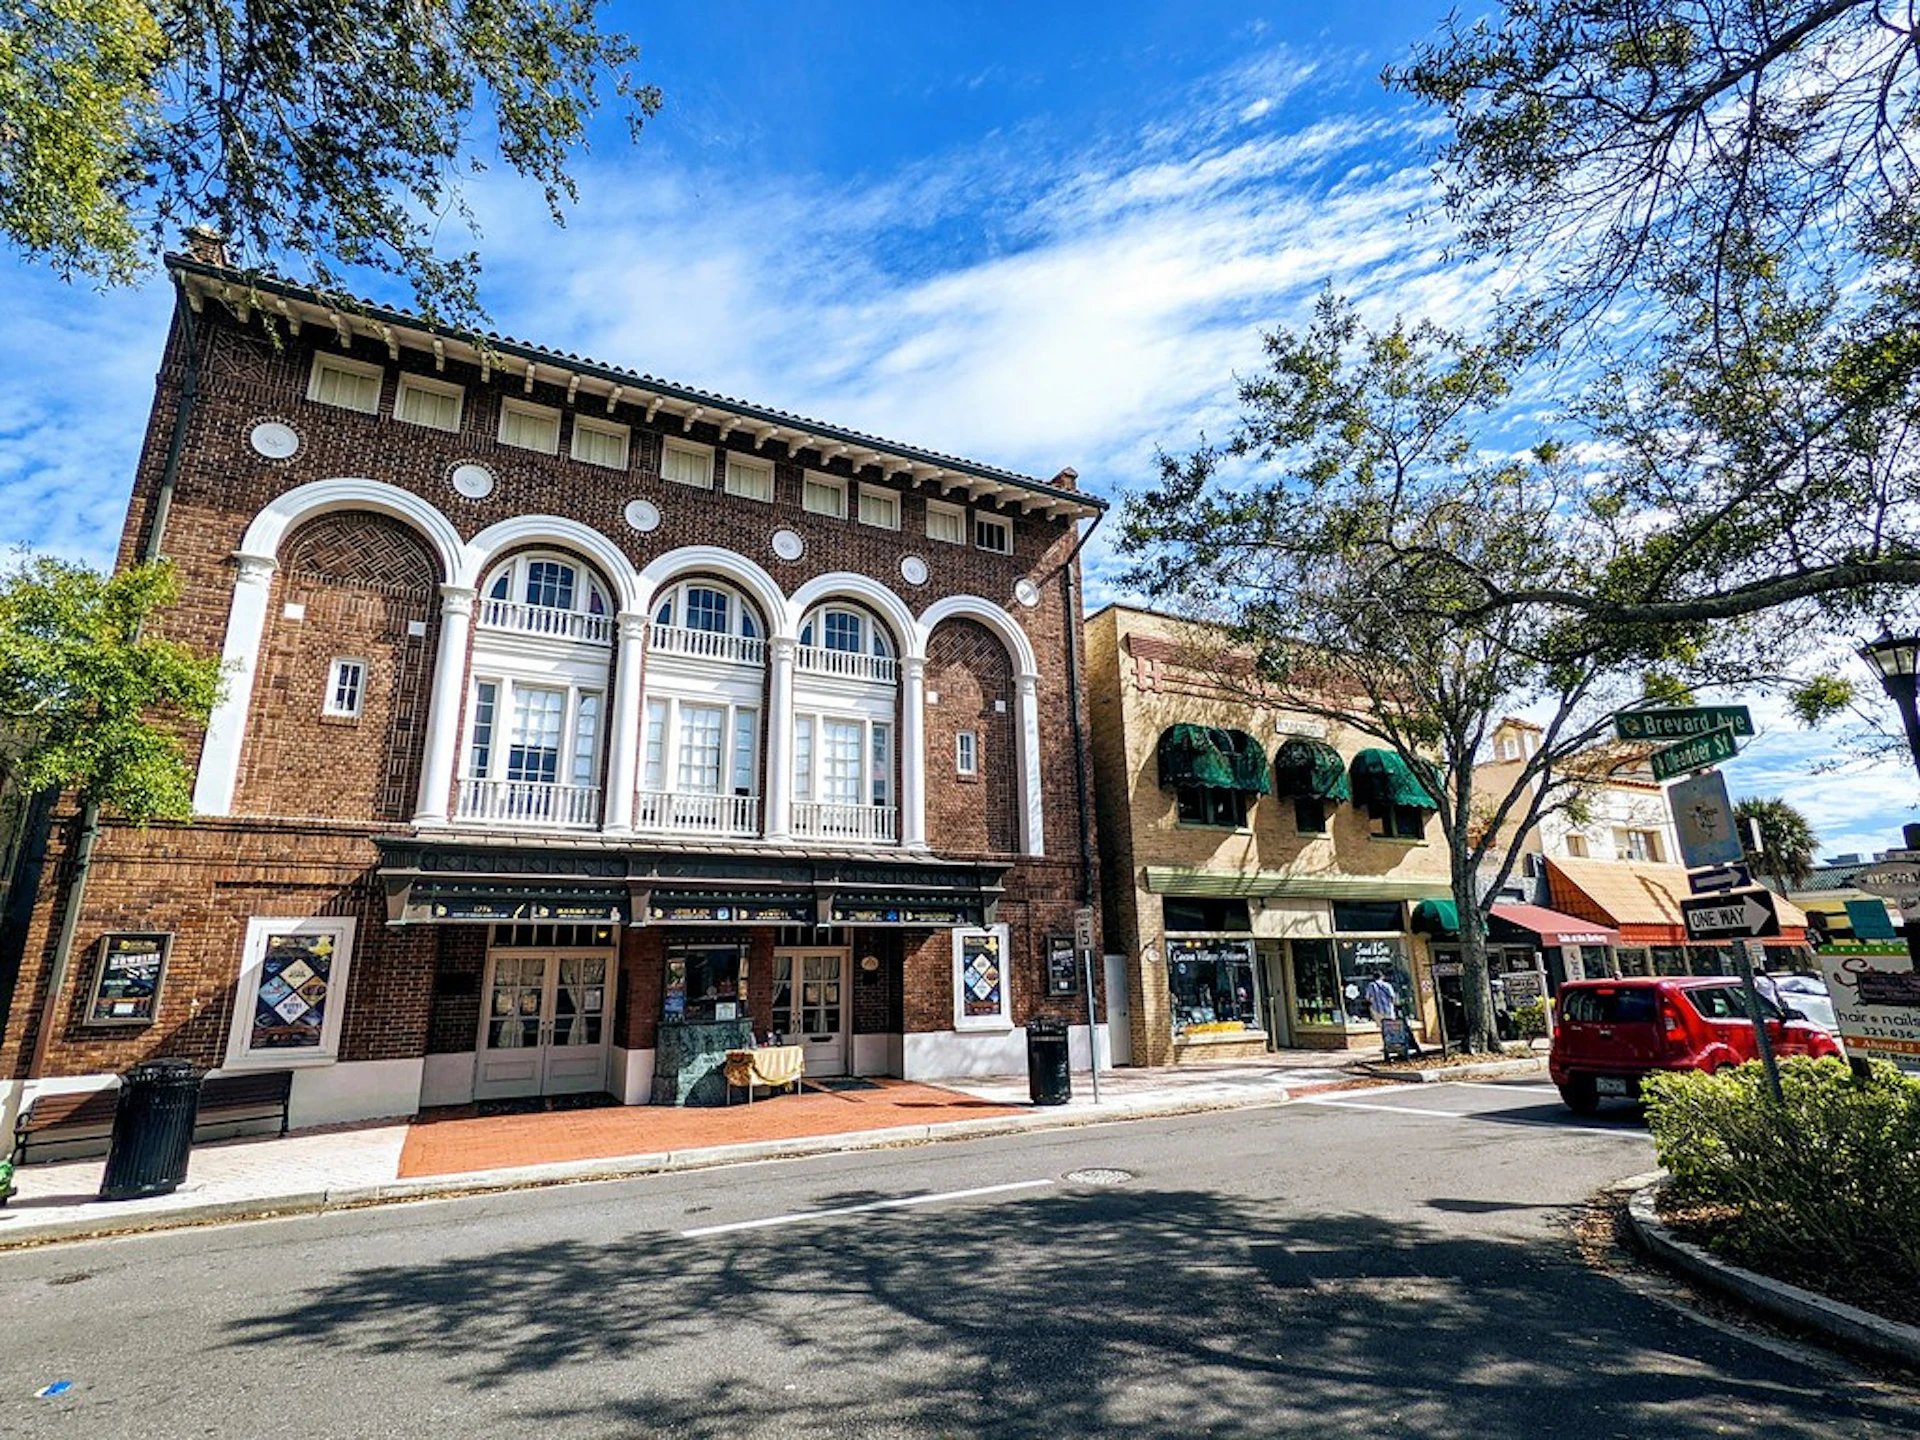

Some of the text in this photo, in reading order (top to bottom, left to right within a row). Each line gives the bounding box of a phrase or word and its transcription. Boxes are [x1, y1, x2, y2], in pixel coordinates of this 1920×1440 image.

[1643, 711, 1745, 735] Brevard Ave
[1713, 733, 1731, 755] St
[1691, 907, 1744, 928] ONE WAY
[1834, 1008, 1867, 1023] hair
